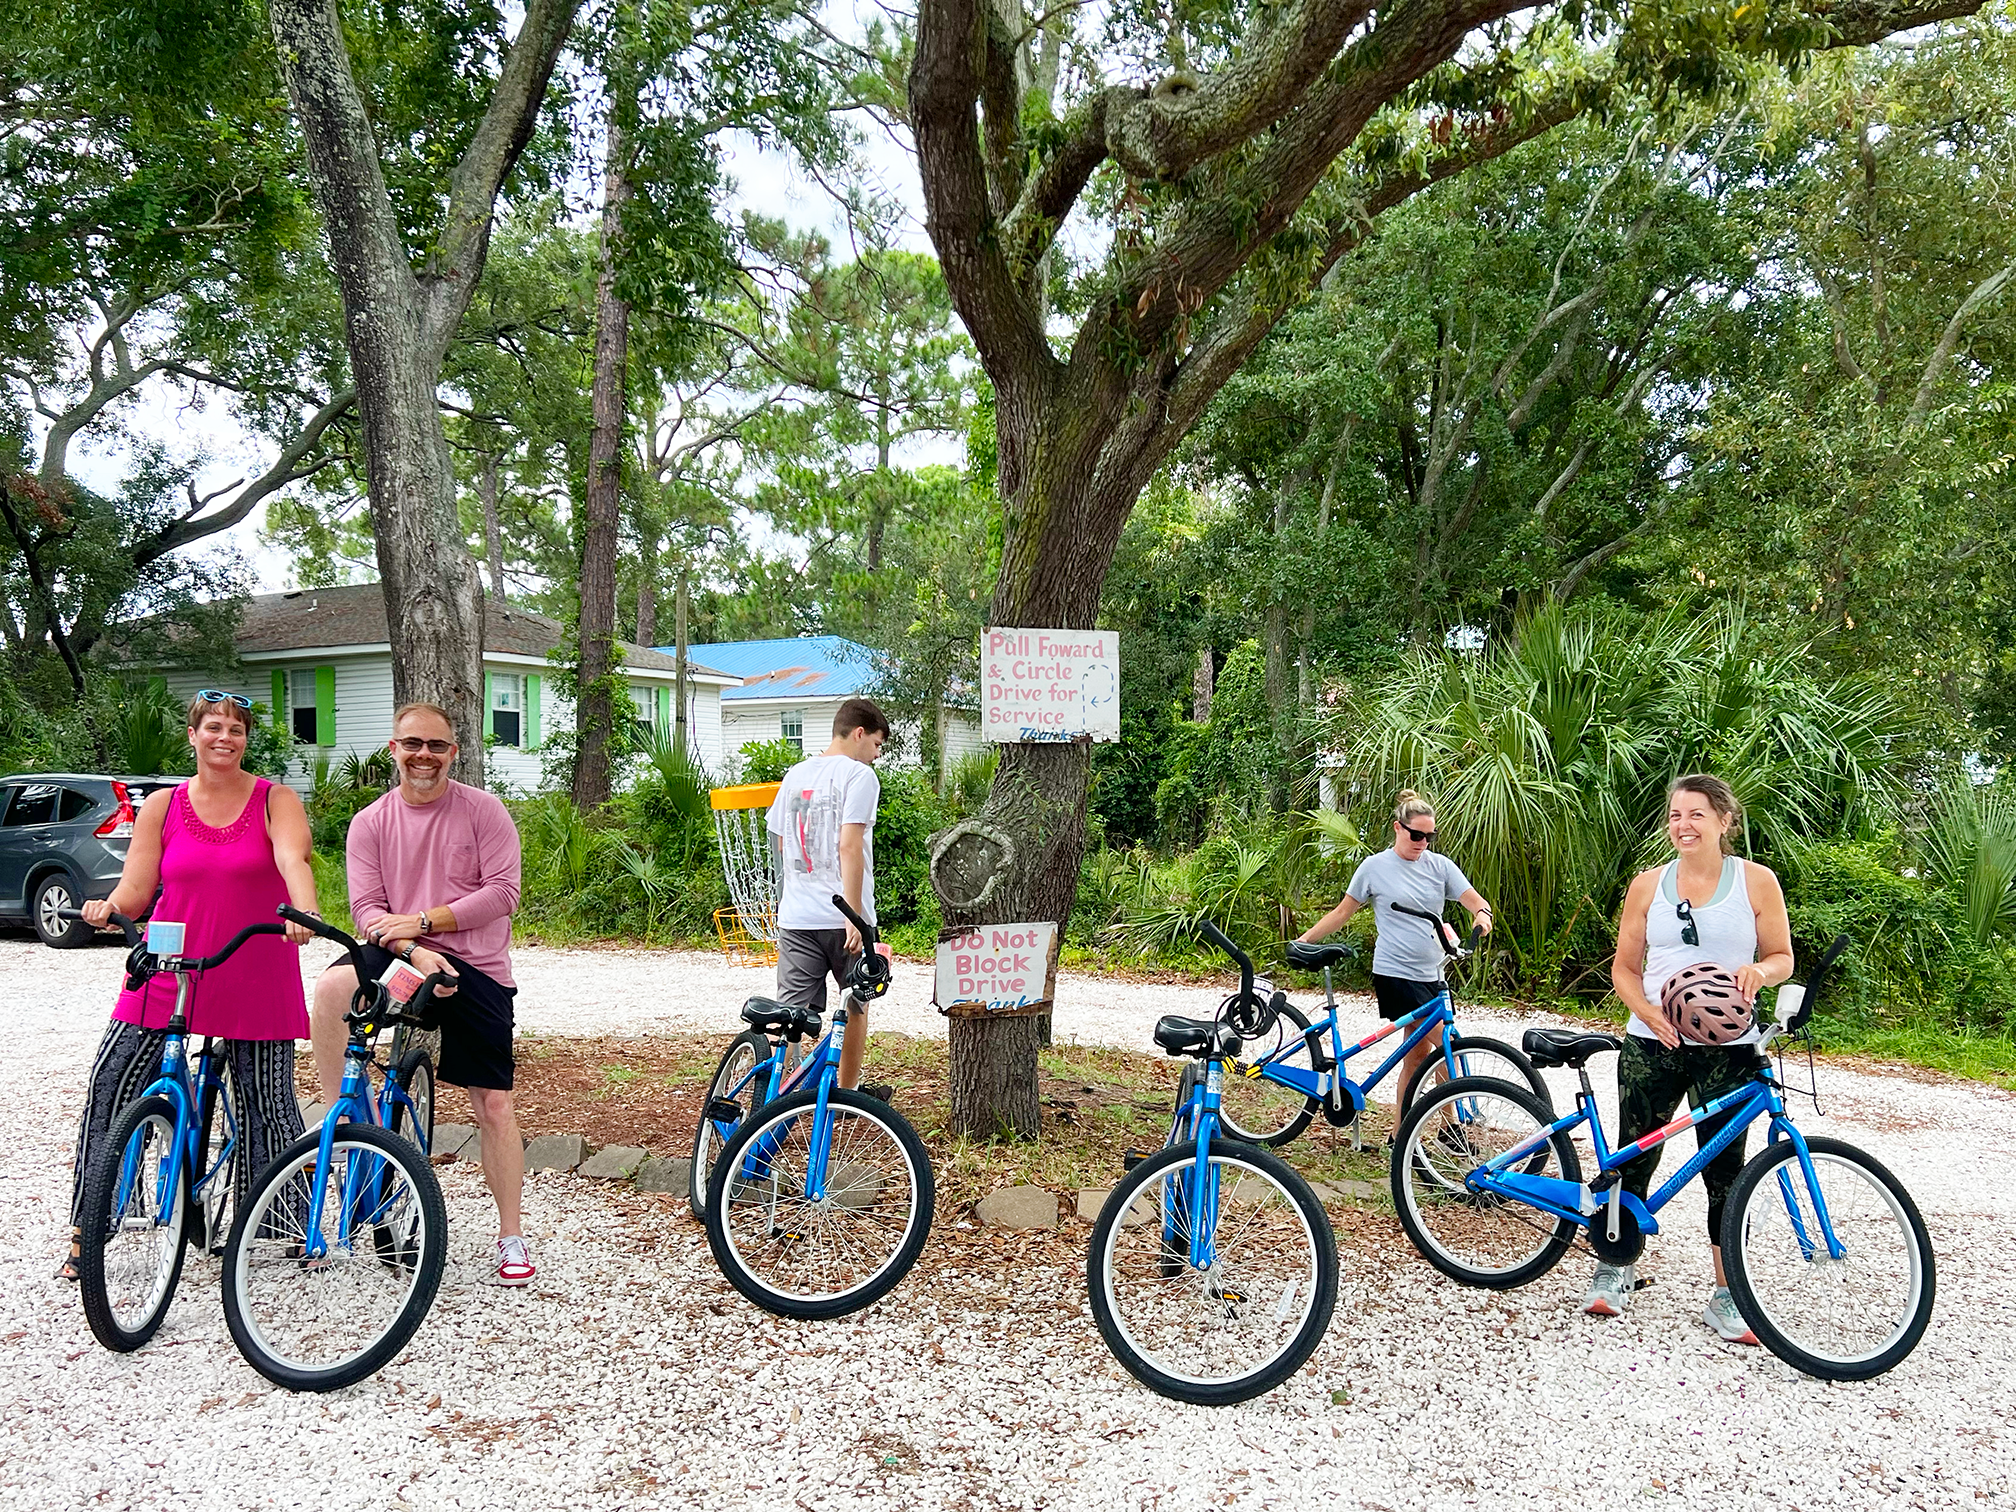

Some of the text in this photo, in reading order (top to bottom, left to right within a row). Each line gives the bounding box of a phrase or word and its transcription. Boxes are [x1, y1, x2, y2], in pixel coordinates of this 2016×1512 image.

[989, 633, 1104, 659] Pull Foward
[987, 660, 1073, 680] & Circle
[989, 682, 1078, 702] Drive for
[989, 706, 1065, 725] Service
[992, 930, 1038, 949] Not
[955, 953, 1031, 975] Block
[958, 974, 1026, 995] Drive
[1662, 1122, 1740, 1200] BOARDWALK
